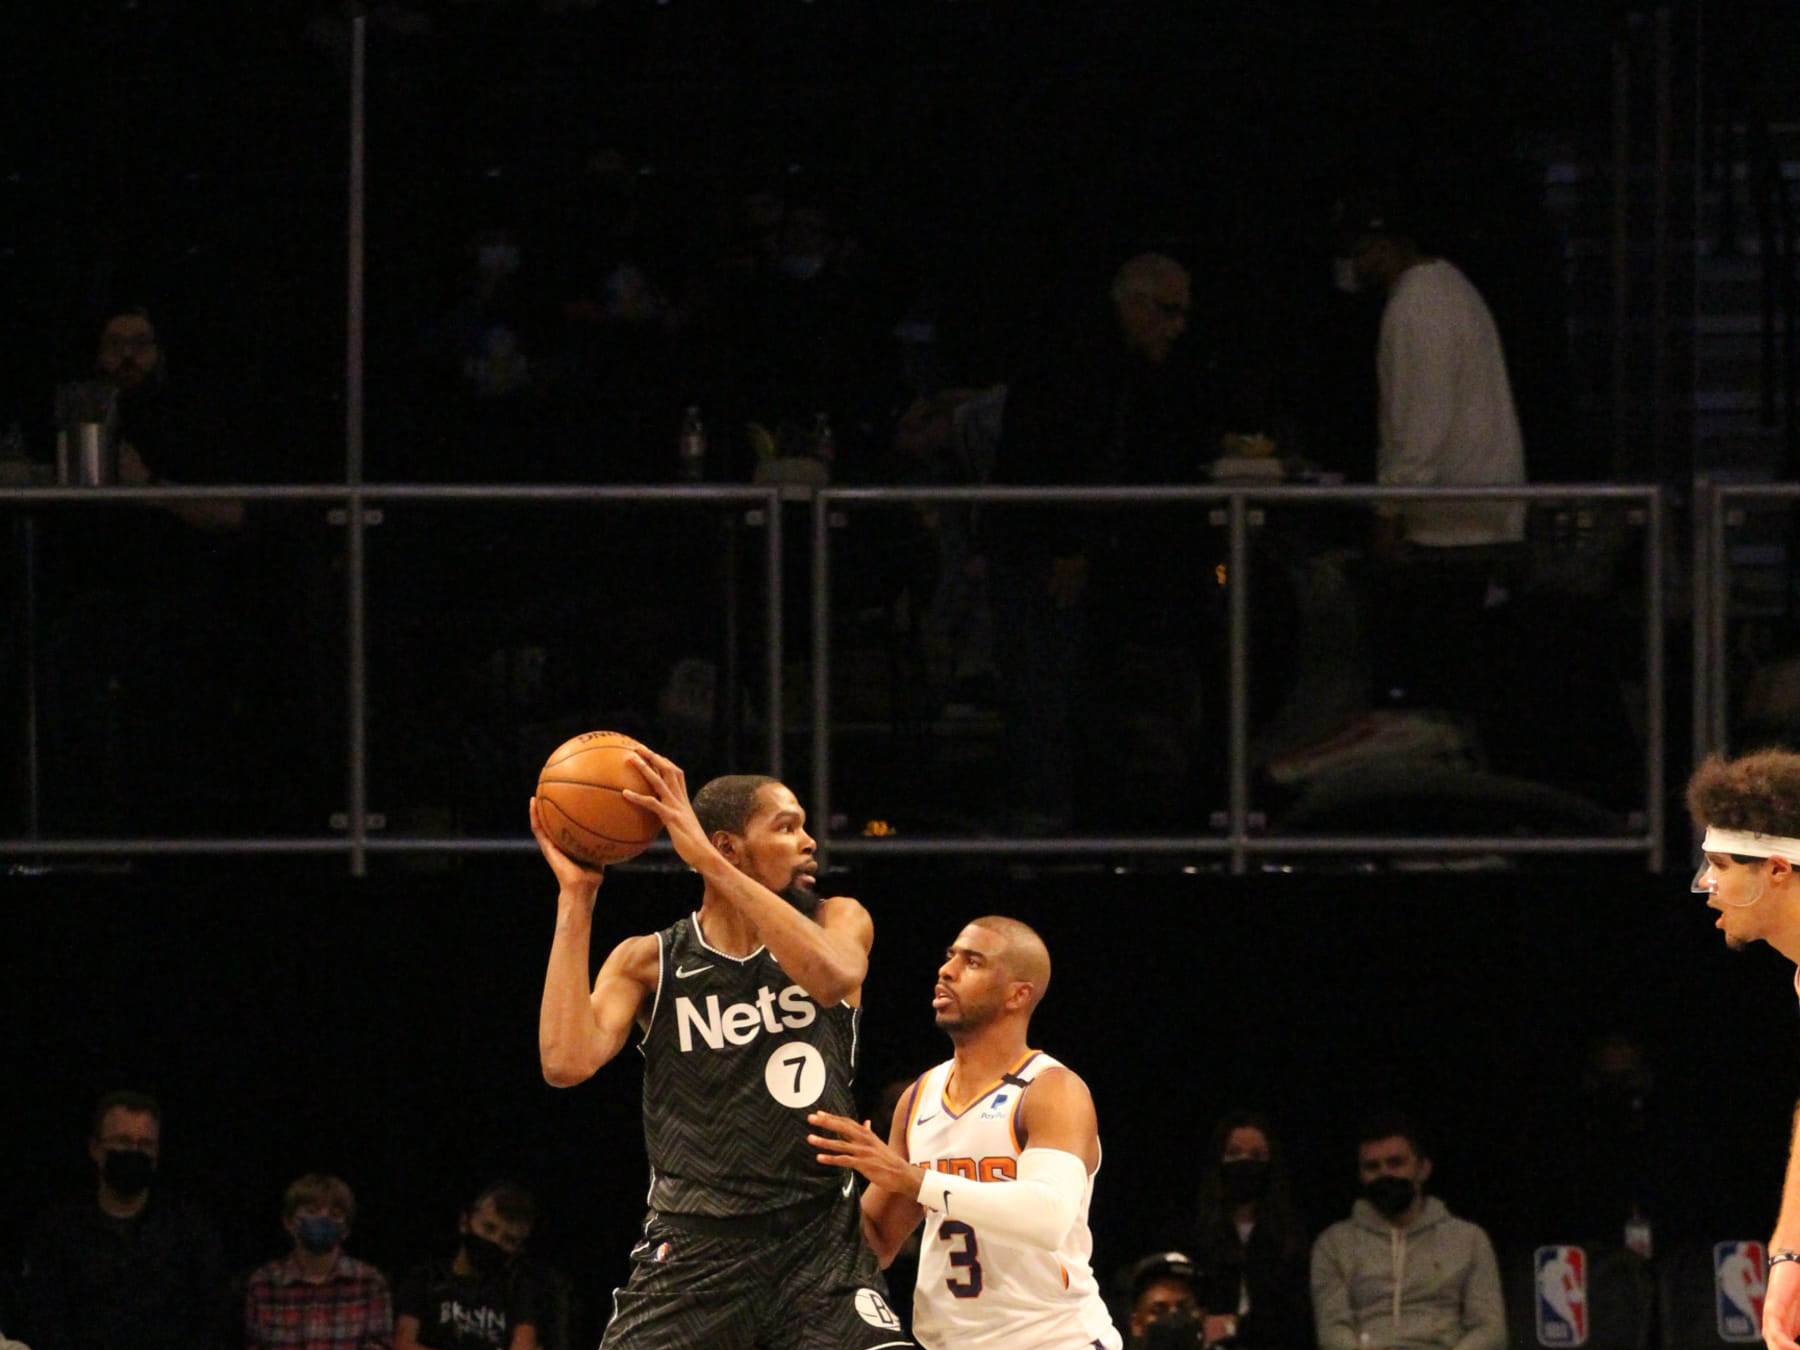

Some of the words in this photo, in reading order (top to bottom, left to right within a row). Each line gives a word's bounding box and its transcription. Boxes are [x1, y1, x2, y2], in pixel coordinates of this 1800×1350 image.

[674, 985, 817, 1053] Nets
[783, 1056, 807, 1094] 7
[938, 1219, 983, 1299] 3
